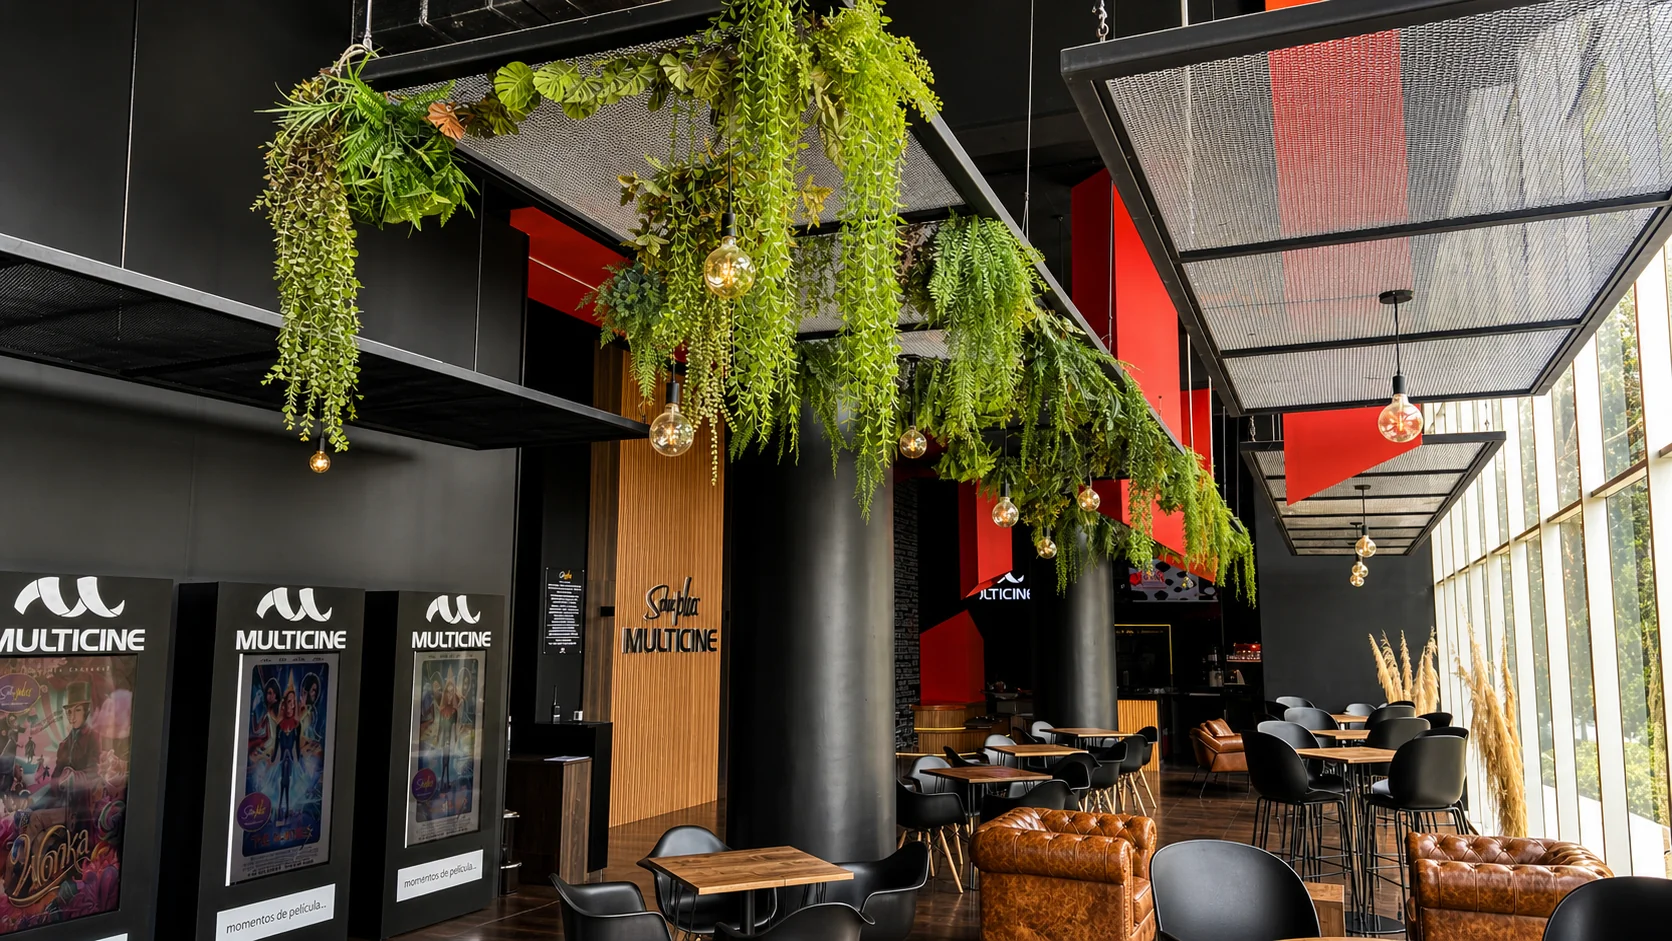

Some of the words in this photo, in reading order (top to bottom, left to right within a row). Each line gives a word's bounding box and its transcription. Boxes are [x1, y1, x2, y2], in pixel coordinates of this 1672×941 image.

[235, 630, 347, 650] MULTICINE
[411, 631, 492, 649] MULTICINE
[622, 627, 717, 653] MULTICINE
[9, 824, 91, 899] Wonka
[404, 872, 439, 888] momentos
[440, 869, 449, 879] de
[226, 913, 275, 933] momentos
[276, 909, 288, 921] de
